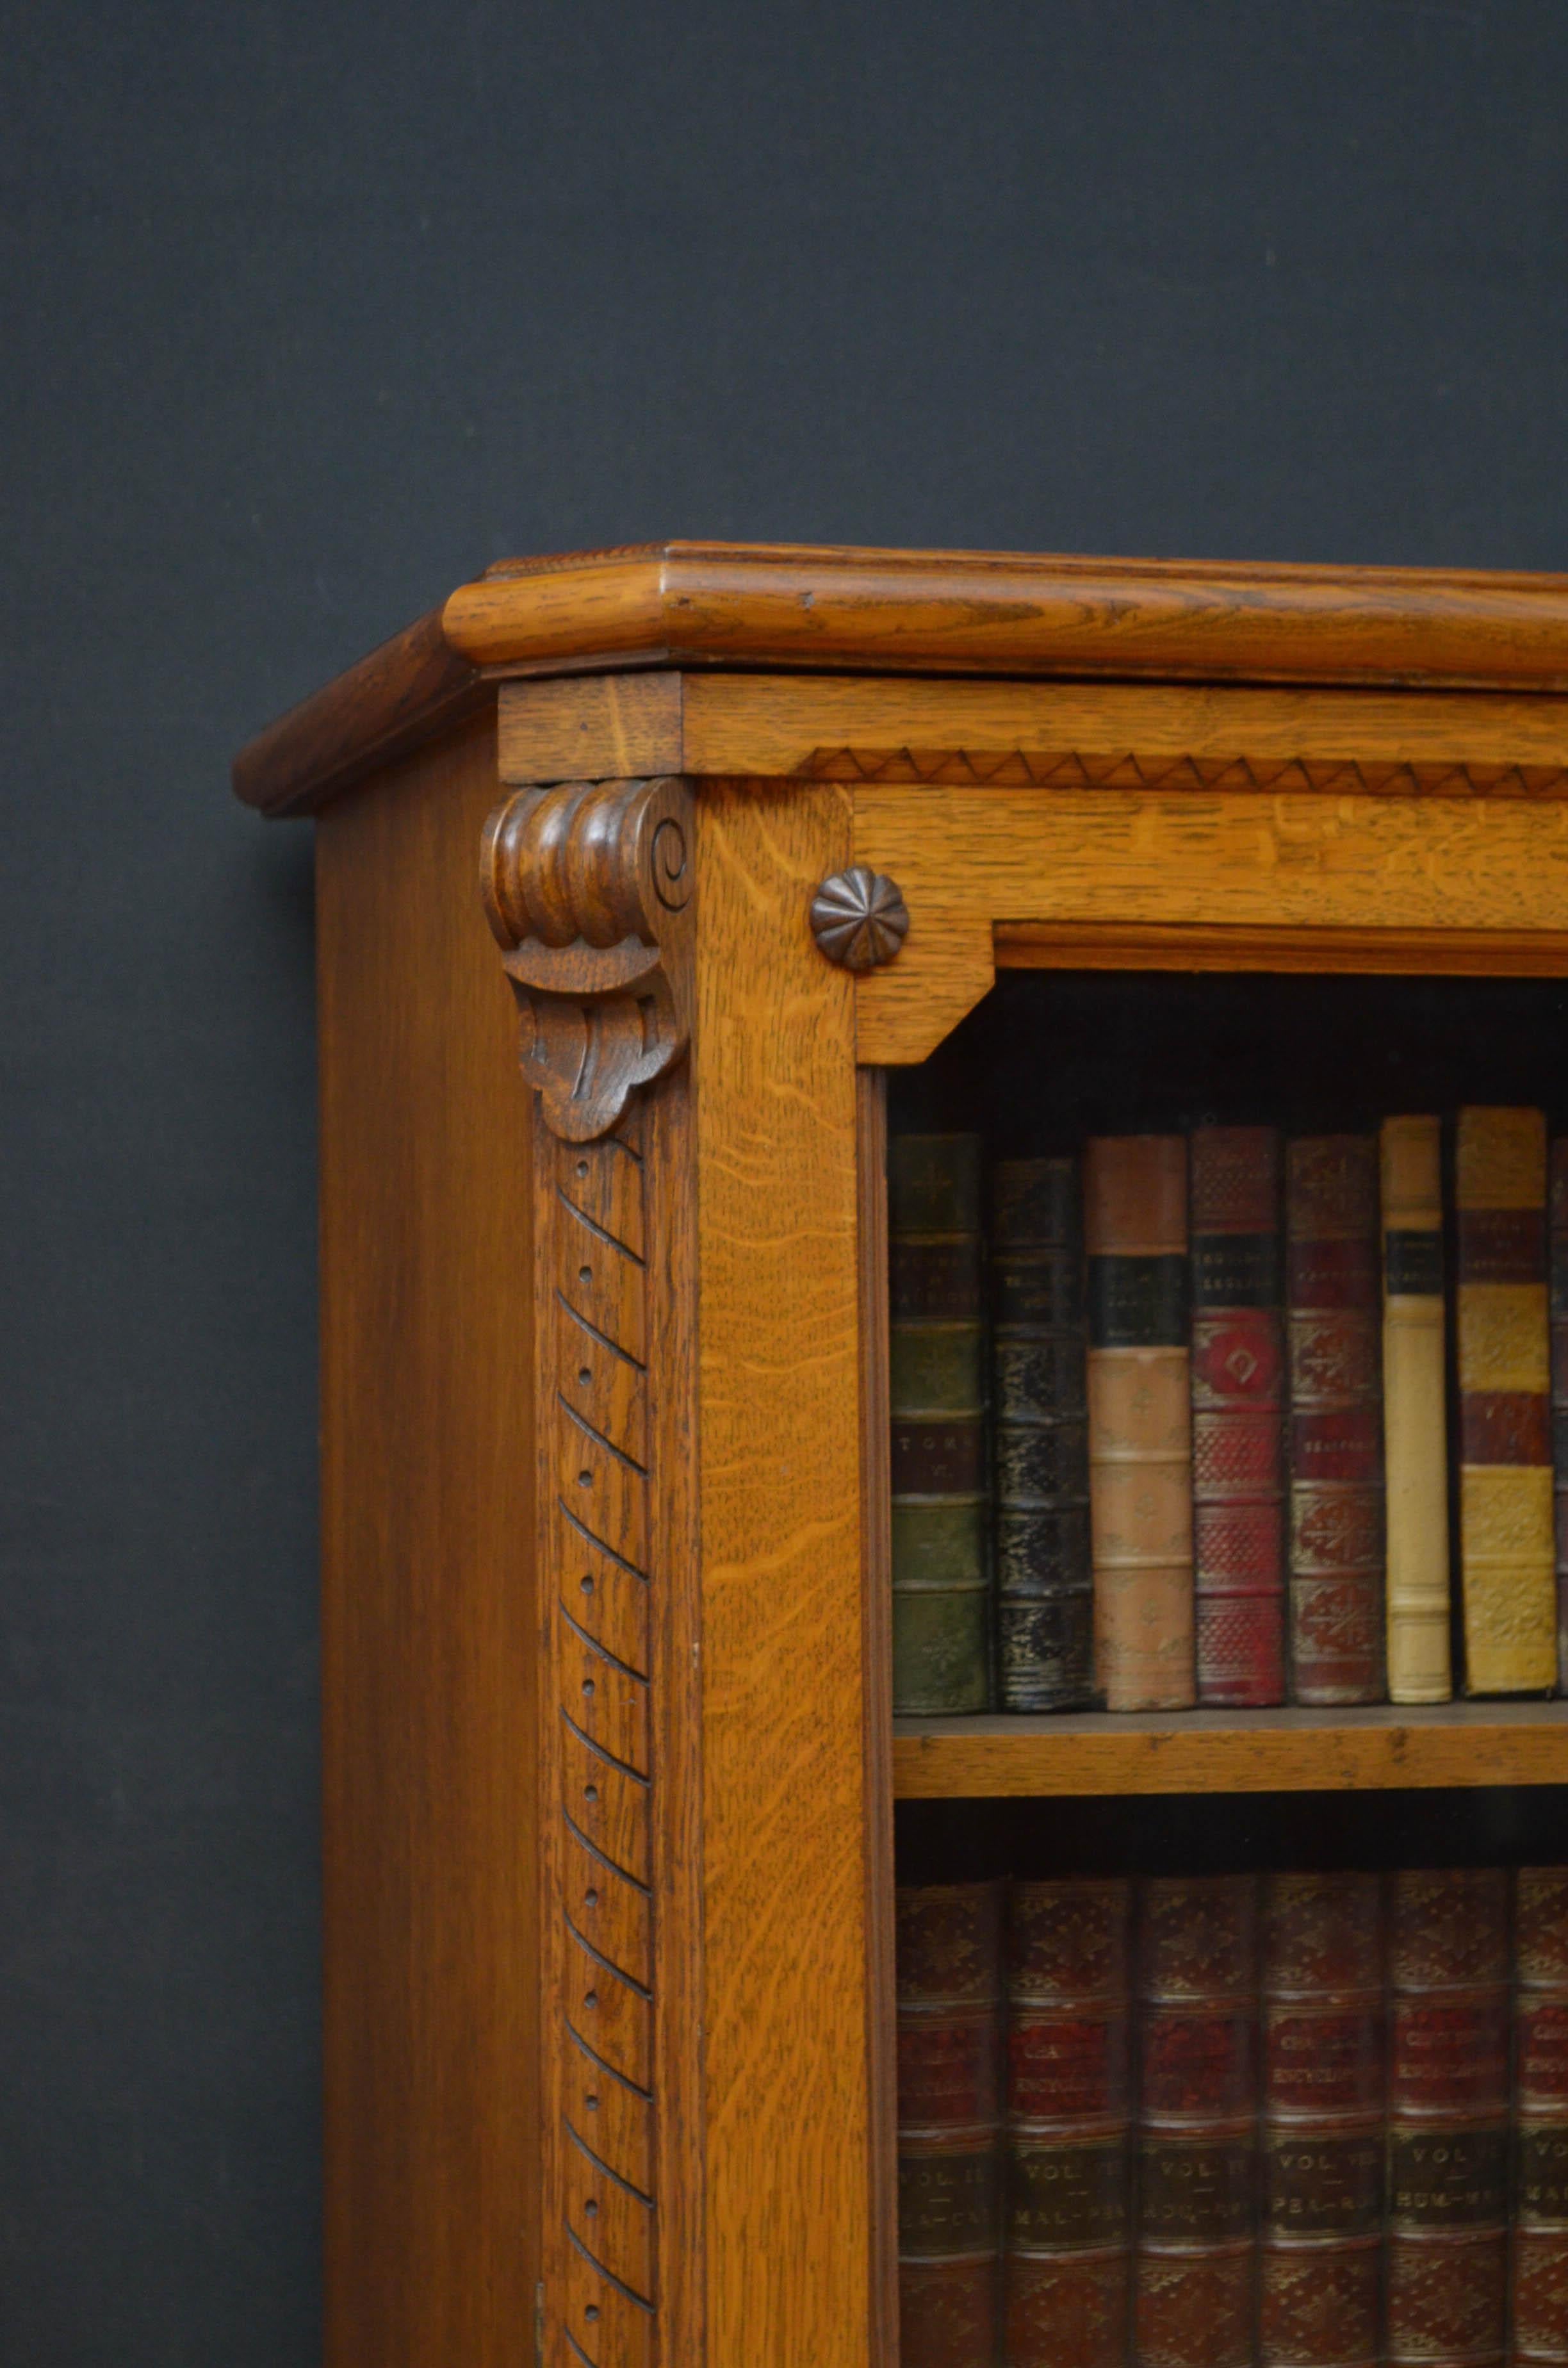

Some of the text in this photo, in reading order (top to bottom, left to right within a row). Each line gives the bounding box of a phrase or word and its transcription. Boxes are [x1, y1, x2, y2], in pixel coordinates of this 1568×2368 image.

[1279, 2154, 1337, 2171] VOL
[1413, 2148, 1467, 2164] VOL
[1025, 2164, 1082, 2180] VOL
[1161, 2161, 1219, 2177] VOL
